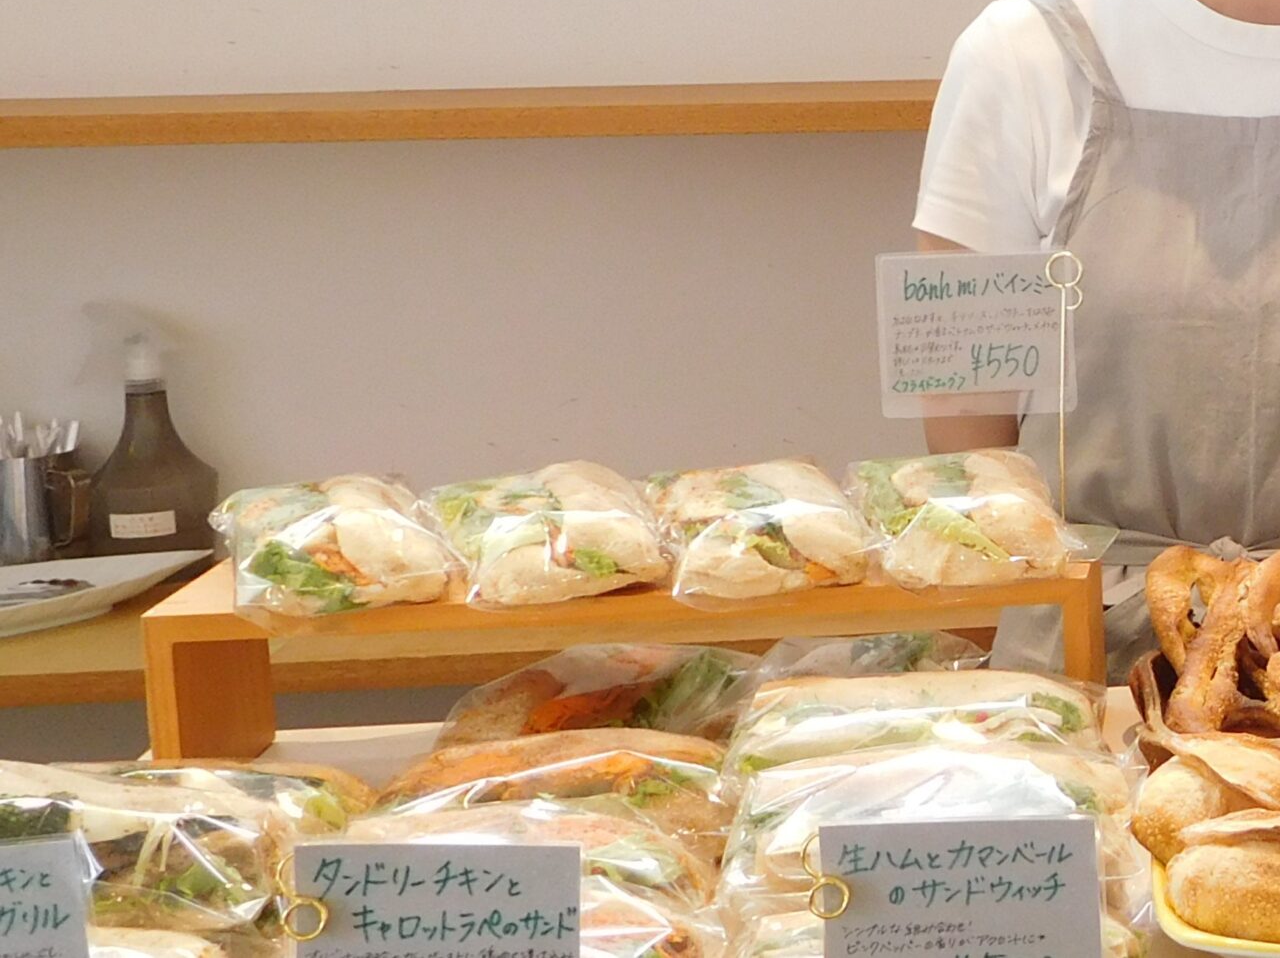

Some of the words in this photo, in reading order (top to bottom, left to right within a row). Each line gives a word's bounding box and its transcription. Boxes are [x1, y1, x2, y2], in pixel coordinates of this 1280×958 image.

[971, 344, 1040, 386] ¥550
[838, 840, 1074, 876] 生ハムとカマンベール
[312, 858, 521, 900] タンドリーチキンと
[889, 872, 1066, 907] のサンドウィッチ
[352, 905, 577, 942] キャロットラペのサンド
